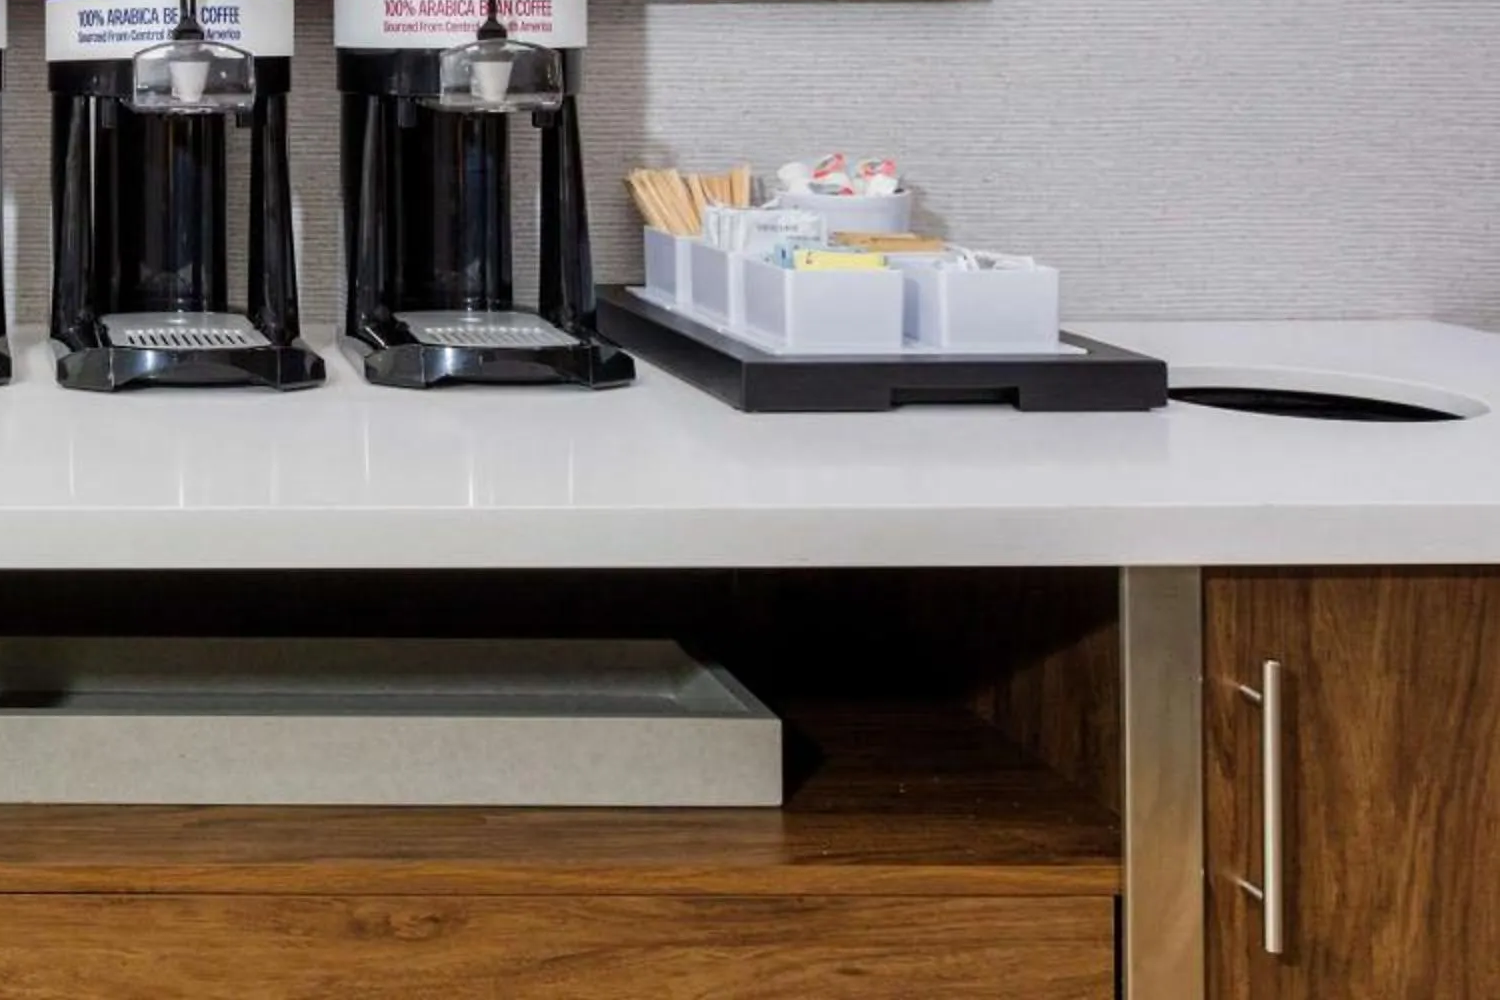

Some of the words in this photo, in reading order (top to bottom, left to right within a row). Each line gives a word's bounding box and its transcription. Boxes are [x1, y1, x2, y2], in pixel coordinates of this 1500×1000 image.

[78, 9, 104, 27] 100%
[107, 7, 159, 25] ARABICA
[163, 7, 190, 25] BE
[201, 6, 240, 24] COFFEE
[384, 0, 416, 17] 100%
[418, 0, 475, 17] ARABICA
[480, 0, 512, 17] BAN
[515, 0, 553, 17] COFFEE
[205, 28, 240, 41] America
